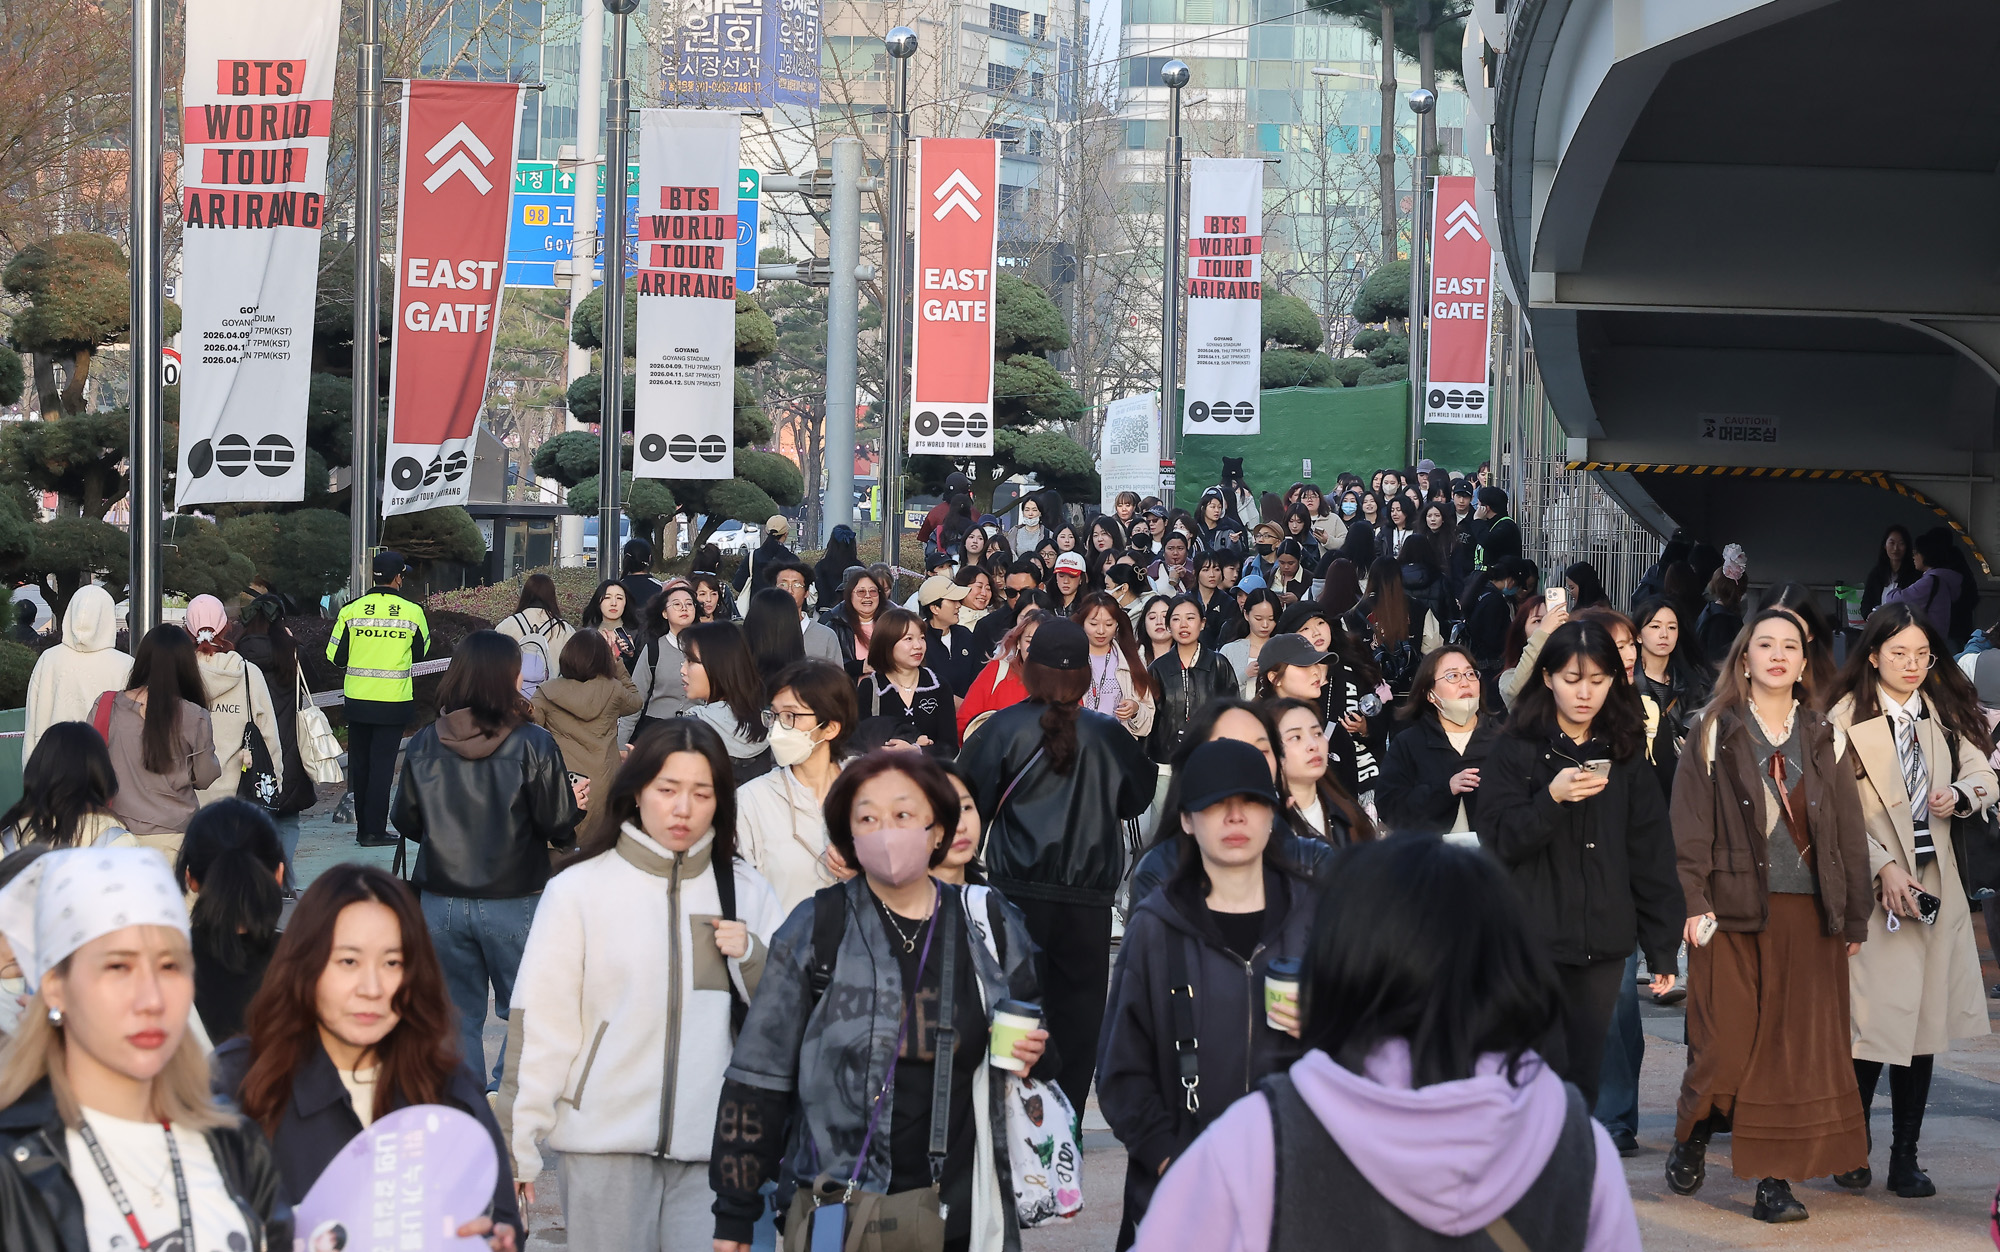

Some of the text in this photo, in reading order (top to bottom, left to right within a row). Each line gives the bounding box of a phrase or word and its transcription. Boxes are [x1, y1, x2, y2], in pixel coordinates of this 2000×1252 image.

[232, 61, 293, 96] BTS
[204, 104, 312, 140] WORLD
[218, 148, 293, 184] TOUR
[670, 187, 710, 211] BTS
[186, 191, 320, 229] ARIRANG
[529, 208, 545, 222] 98
[651, 215, 724, 240] WORLD
[1211, 216, 1240, 234] BTS
[1199, 237, 1252, 256] WORLD
[661, 244, 715, 269] TOUR
[408, 258, 499, 290] EAST
[1204, 260, 1245, 277] TOUR
[640, 272, 733, 299] ARIRANG
[924, 267, 988, 291] EAST
[1435, 277, 1486, 296] EAST
[1190, 281, 1259, 299] ARIRANG
[404, 301, 492, 333] GATE
[923, 299, 987, 322] GATE
[1433, 301, 1485, 320] GATE
[255, 327, 292, 335] 7PM(KST)
[253, 339, 290, 348] 7PM(KST)
[254, 352, 291, 360] 7PM(KST)
[1724, 416, 1772, 426] CAUTION!
[1719, 426, 1777, 443] 머리조심
[915, 440, 926, 448] BTS
[927, 440, 945, 448] WORLD
[965, 441, 987, 449] ARIRANG
[391, 497, 405, 506] BTS
[420, 492, 434, 501] TOUR
[355, 629, 407, 639] POLICE
